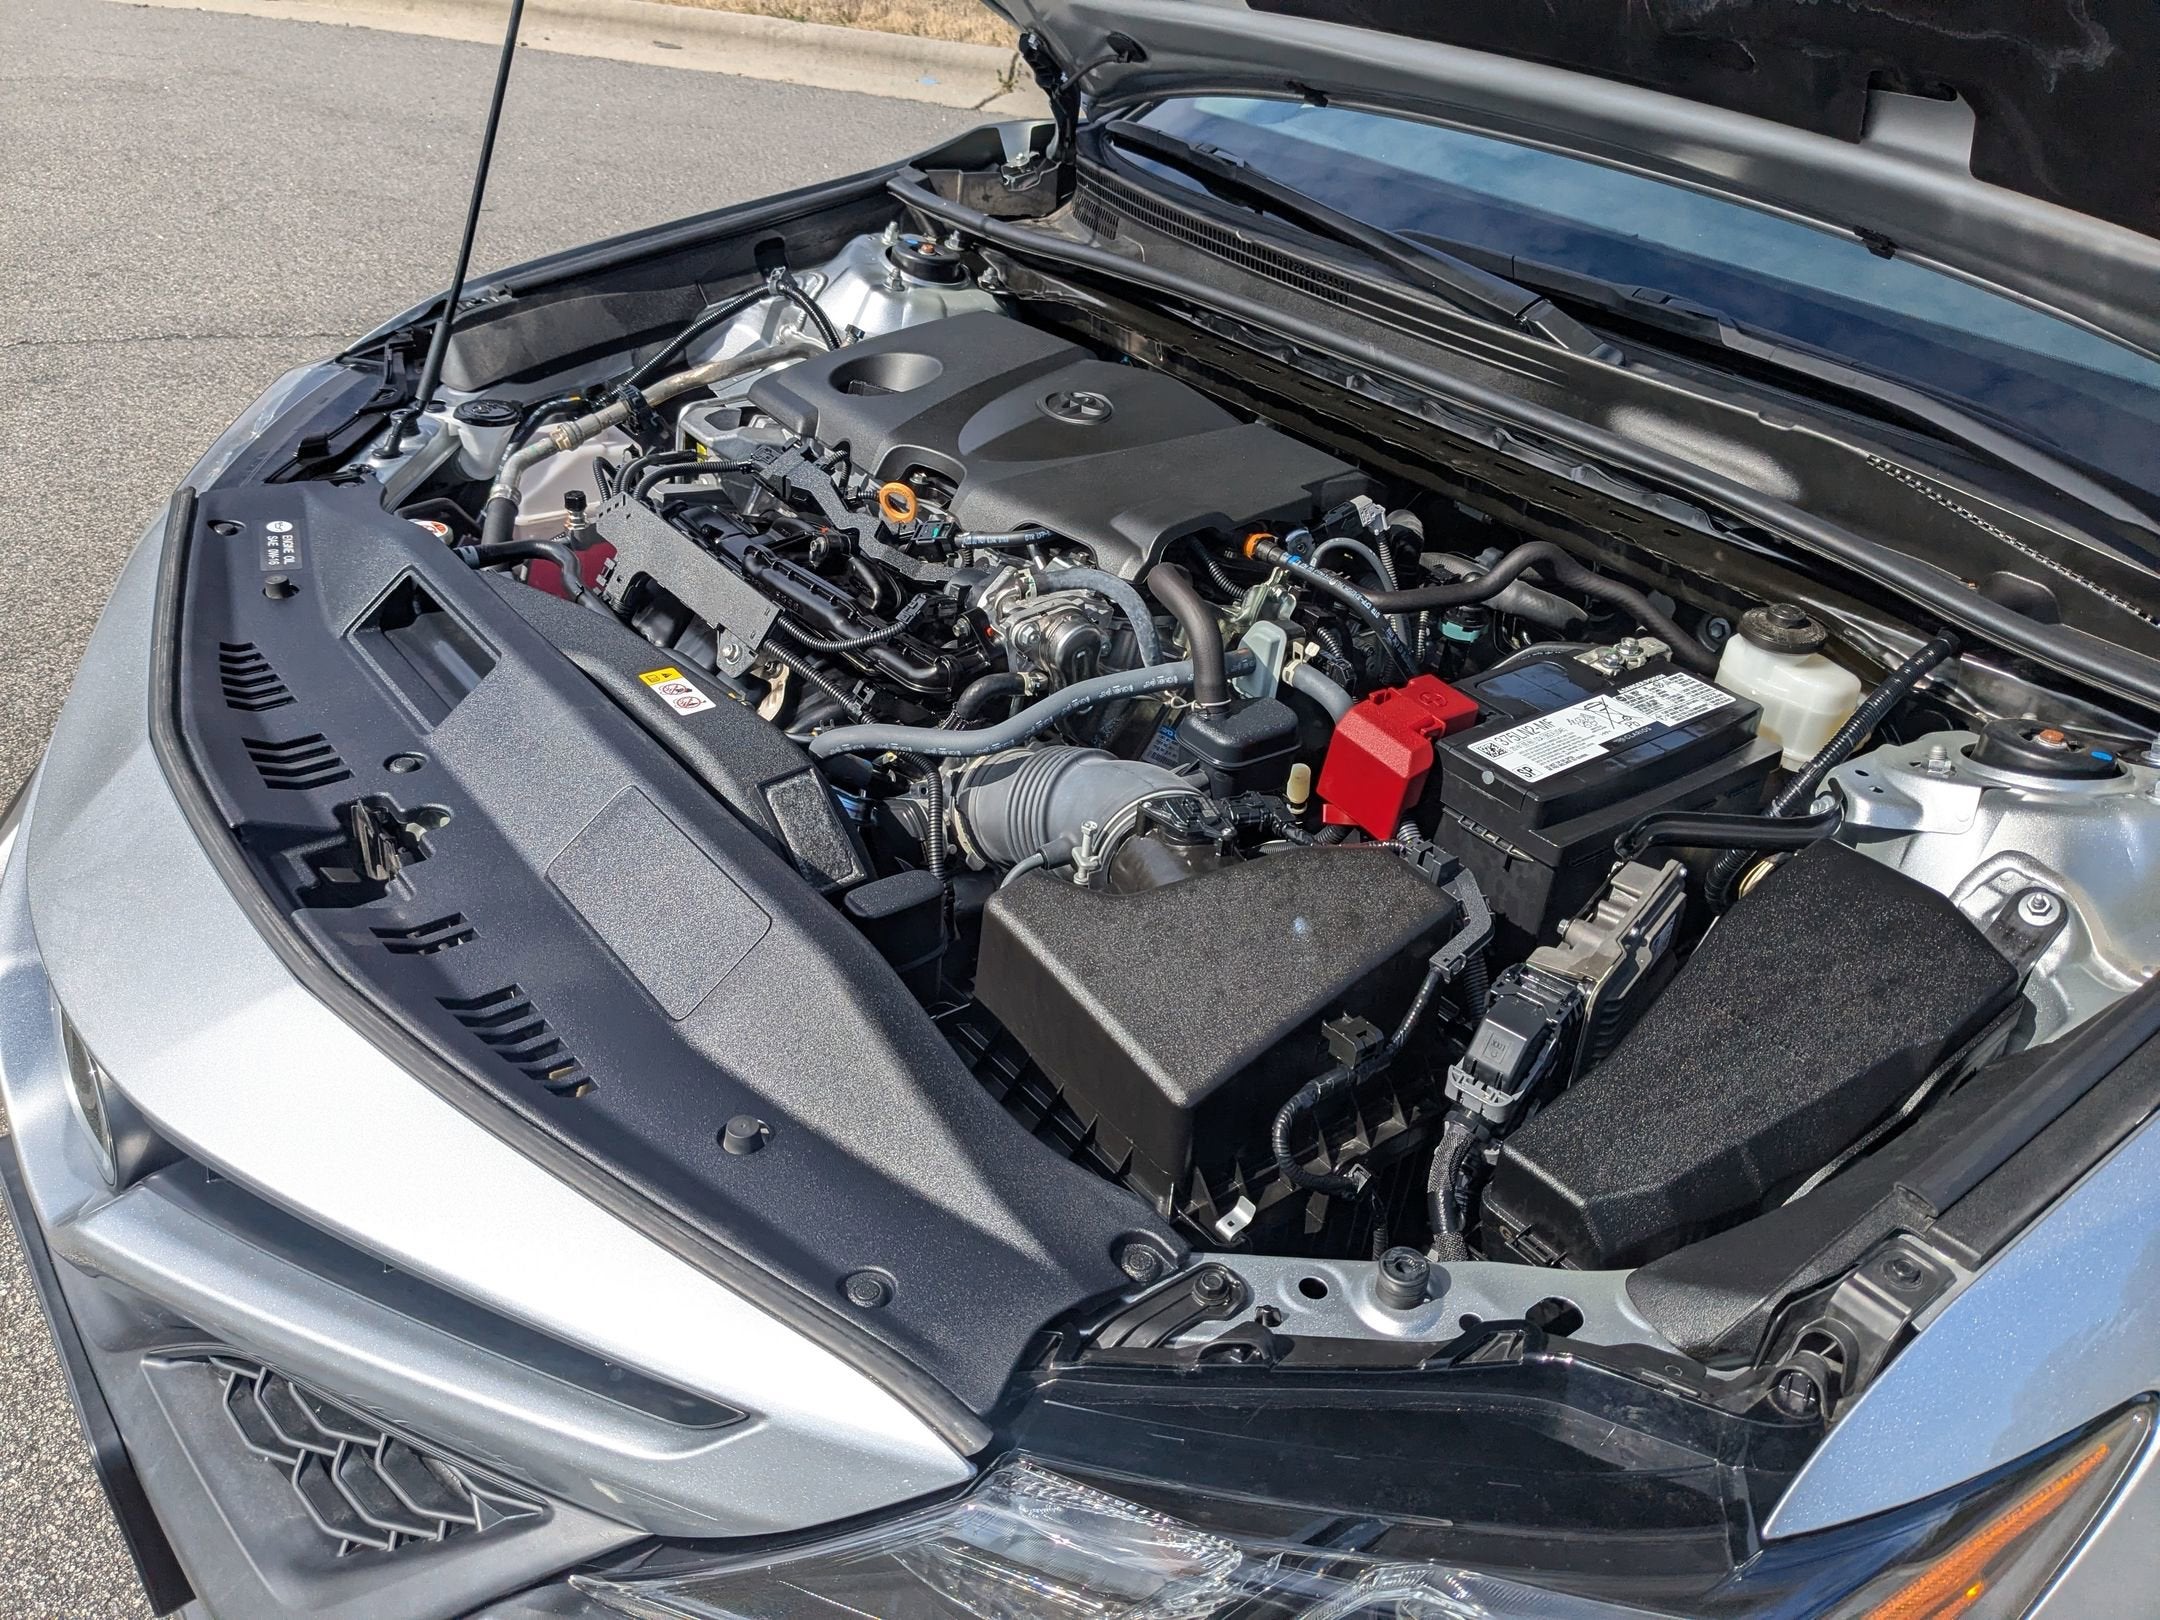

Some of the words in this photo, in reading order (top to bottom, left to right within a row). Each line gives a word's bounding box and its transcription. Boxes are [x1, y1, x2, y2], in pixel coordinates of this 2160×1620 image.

[267, 535, 279, 547] SAE
[282, 534, 295, 553] ENGINE
[267, 549, 280, 565] 0W-16
[283, 555, 295, 565] OIL
[1495, 719, 1555, 745] 375LN2-MF
[1517, 766, 1537, 778] SP
